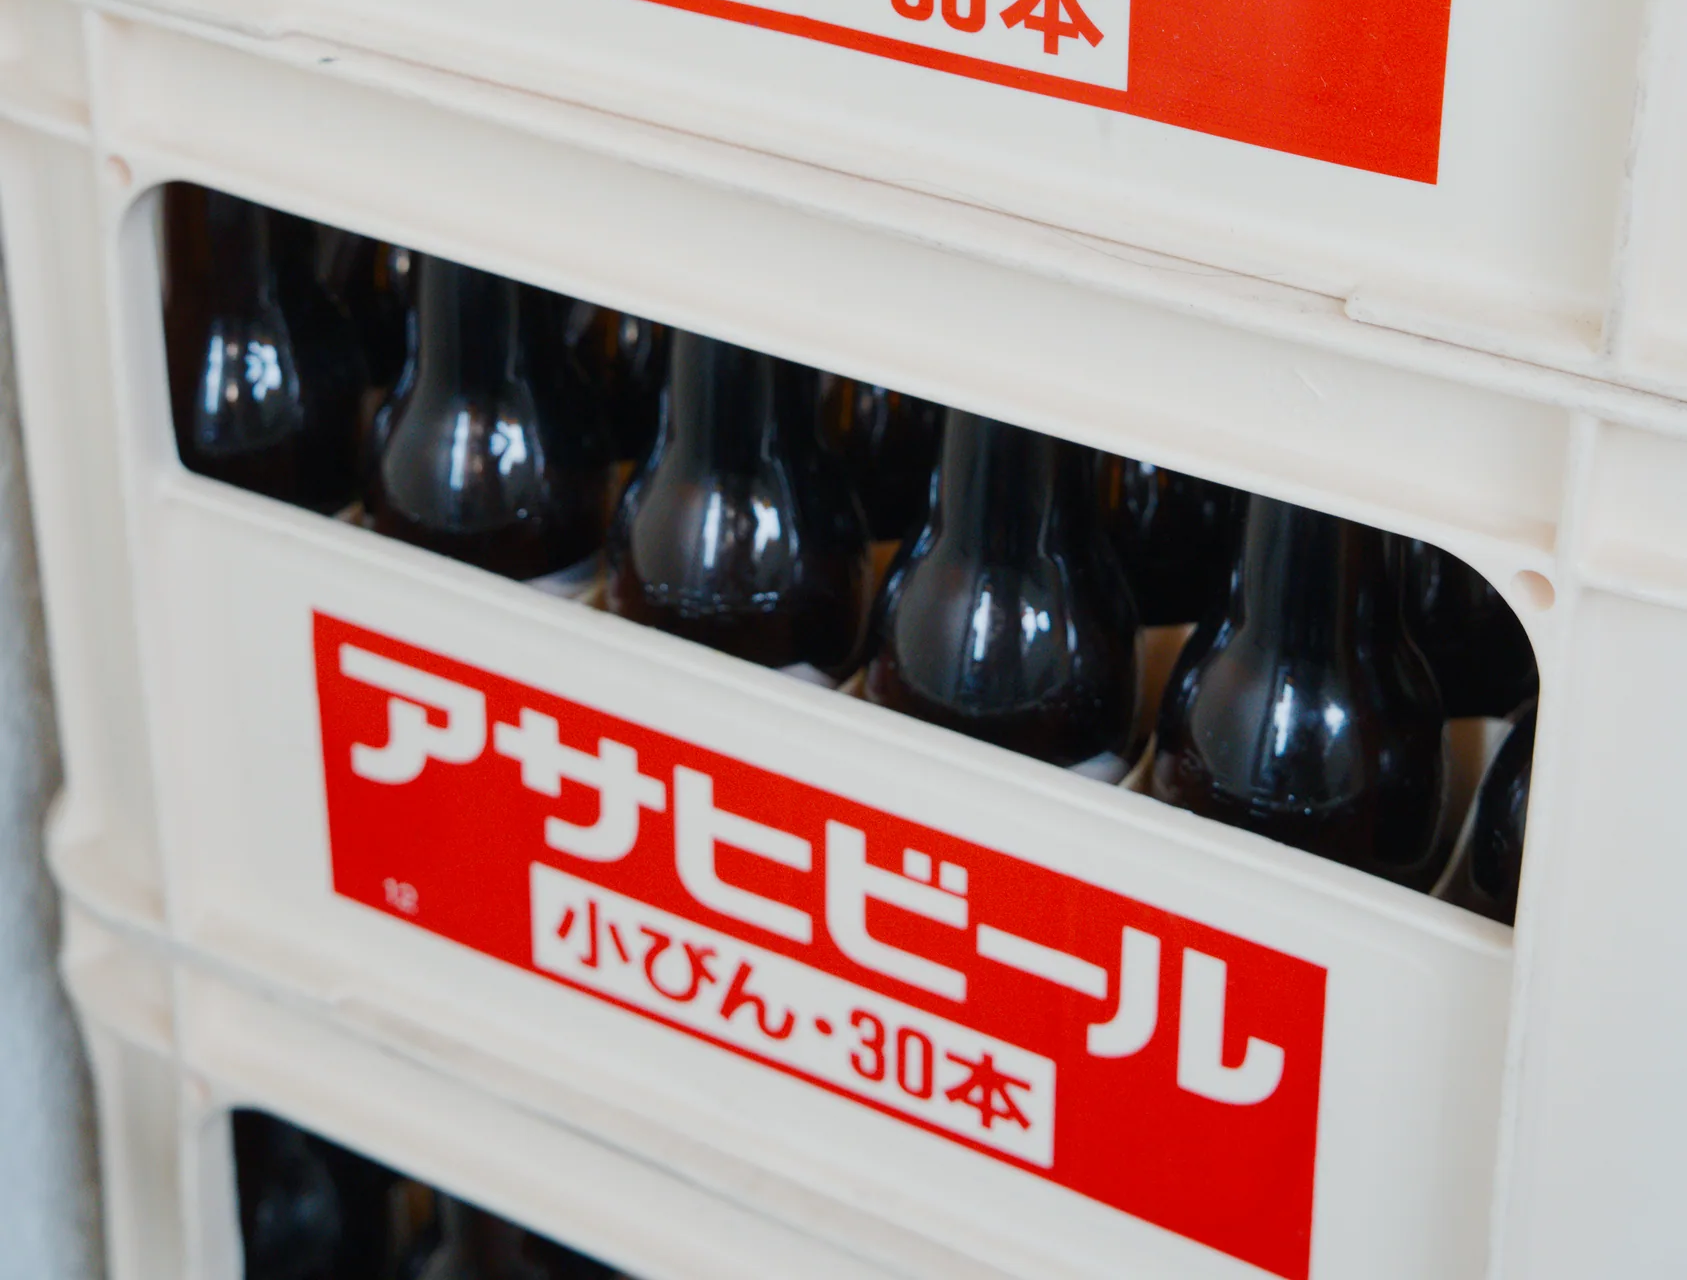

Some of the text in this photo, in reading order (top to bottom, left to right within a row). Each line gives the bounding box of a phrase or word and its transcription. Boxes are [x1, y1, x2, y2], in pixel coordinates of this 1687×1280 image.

[339, 644, 1284, 1105] アサヒビール
[556, 900, 1032, 1131] 小びん・30本
